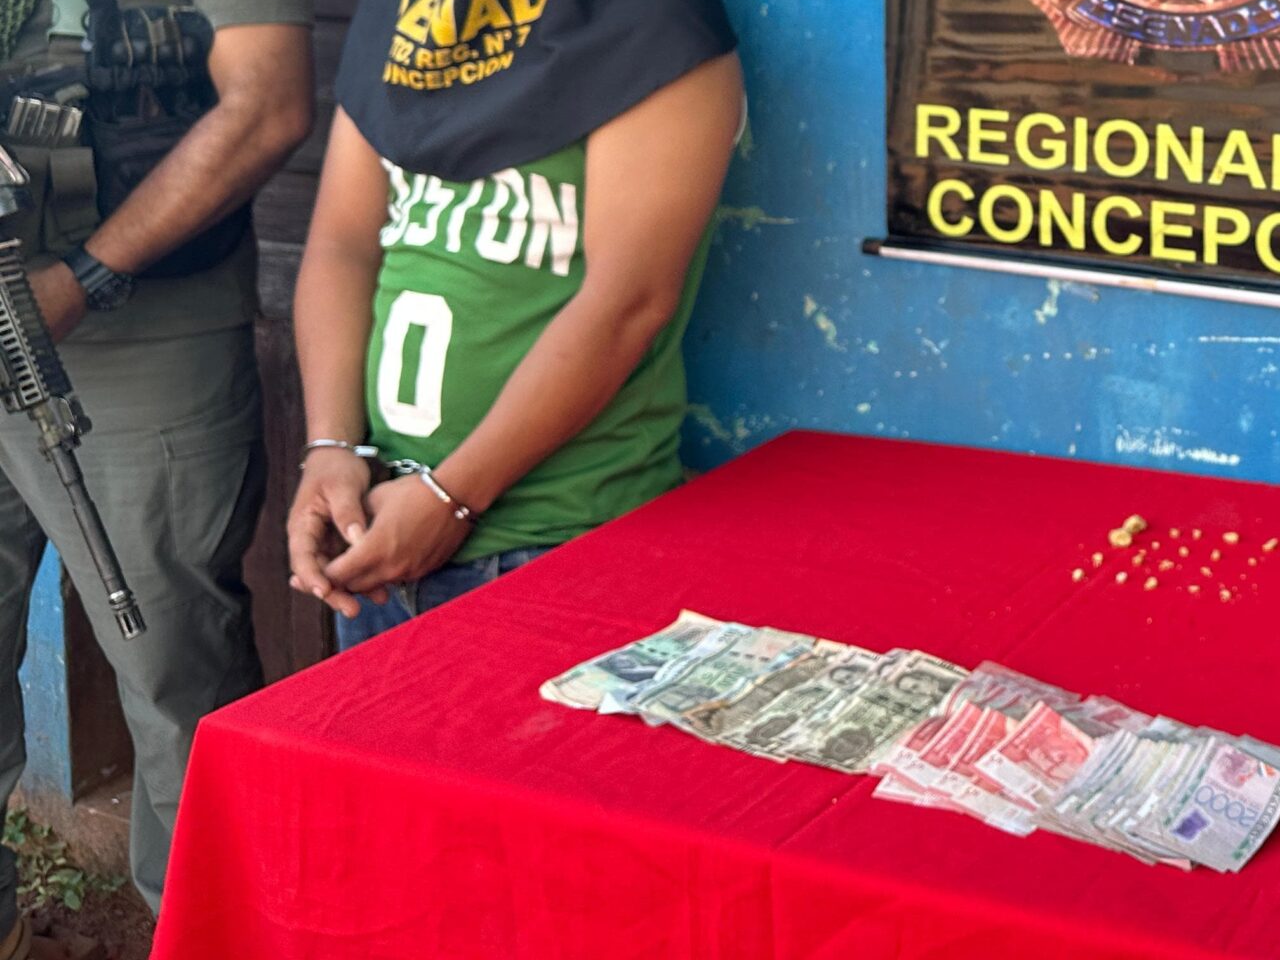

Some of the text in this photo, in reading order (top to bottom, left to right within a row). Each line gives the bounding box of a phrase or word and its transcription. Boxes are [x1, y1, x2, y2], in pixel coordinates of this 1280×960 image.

[415, 43, 479, 70] REG.
[515, 24, 532, 48] 7
[378, 290, 453, 437] 0
